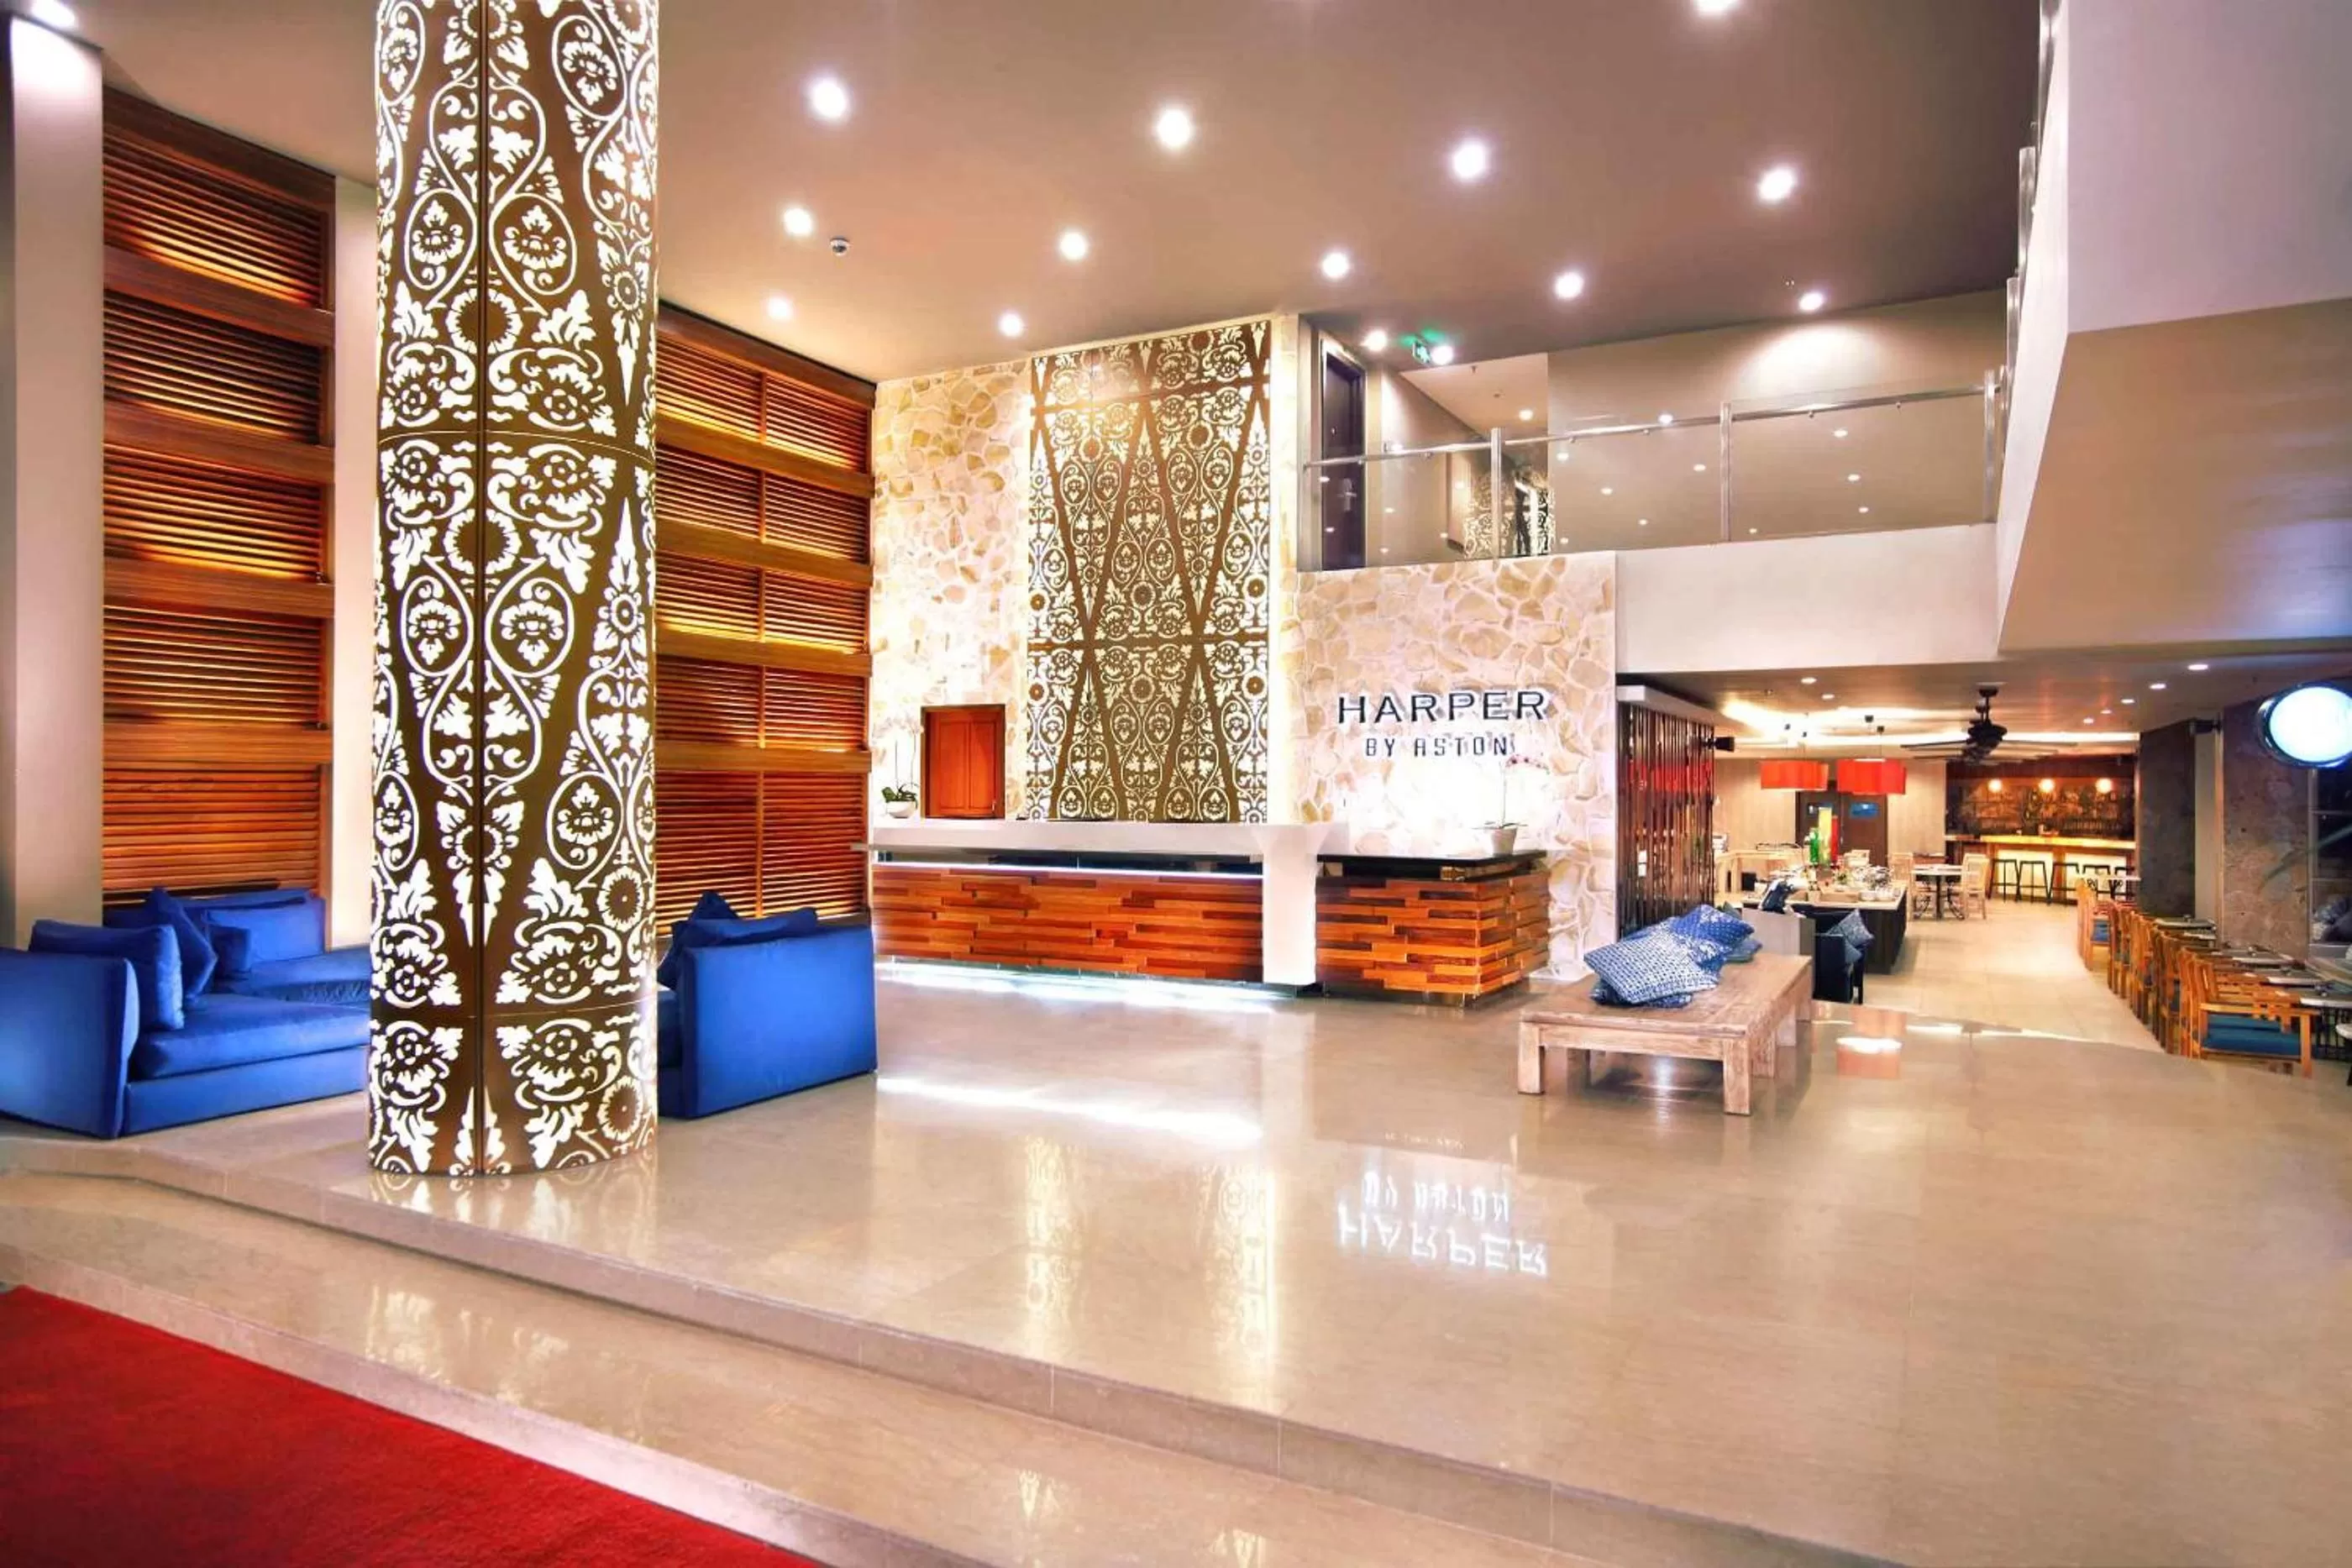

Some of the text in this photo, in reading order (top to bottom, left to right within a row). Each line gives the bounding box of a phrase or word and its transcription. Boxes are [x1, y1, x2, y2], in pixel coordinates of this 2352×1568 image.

[1337, 690, 1546, 724] HARPER
[1366, 737, 1508, 757] BY ASTON
